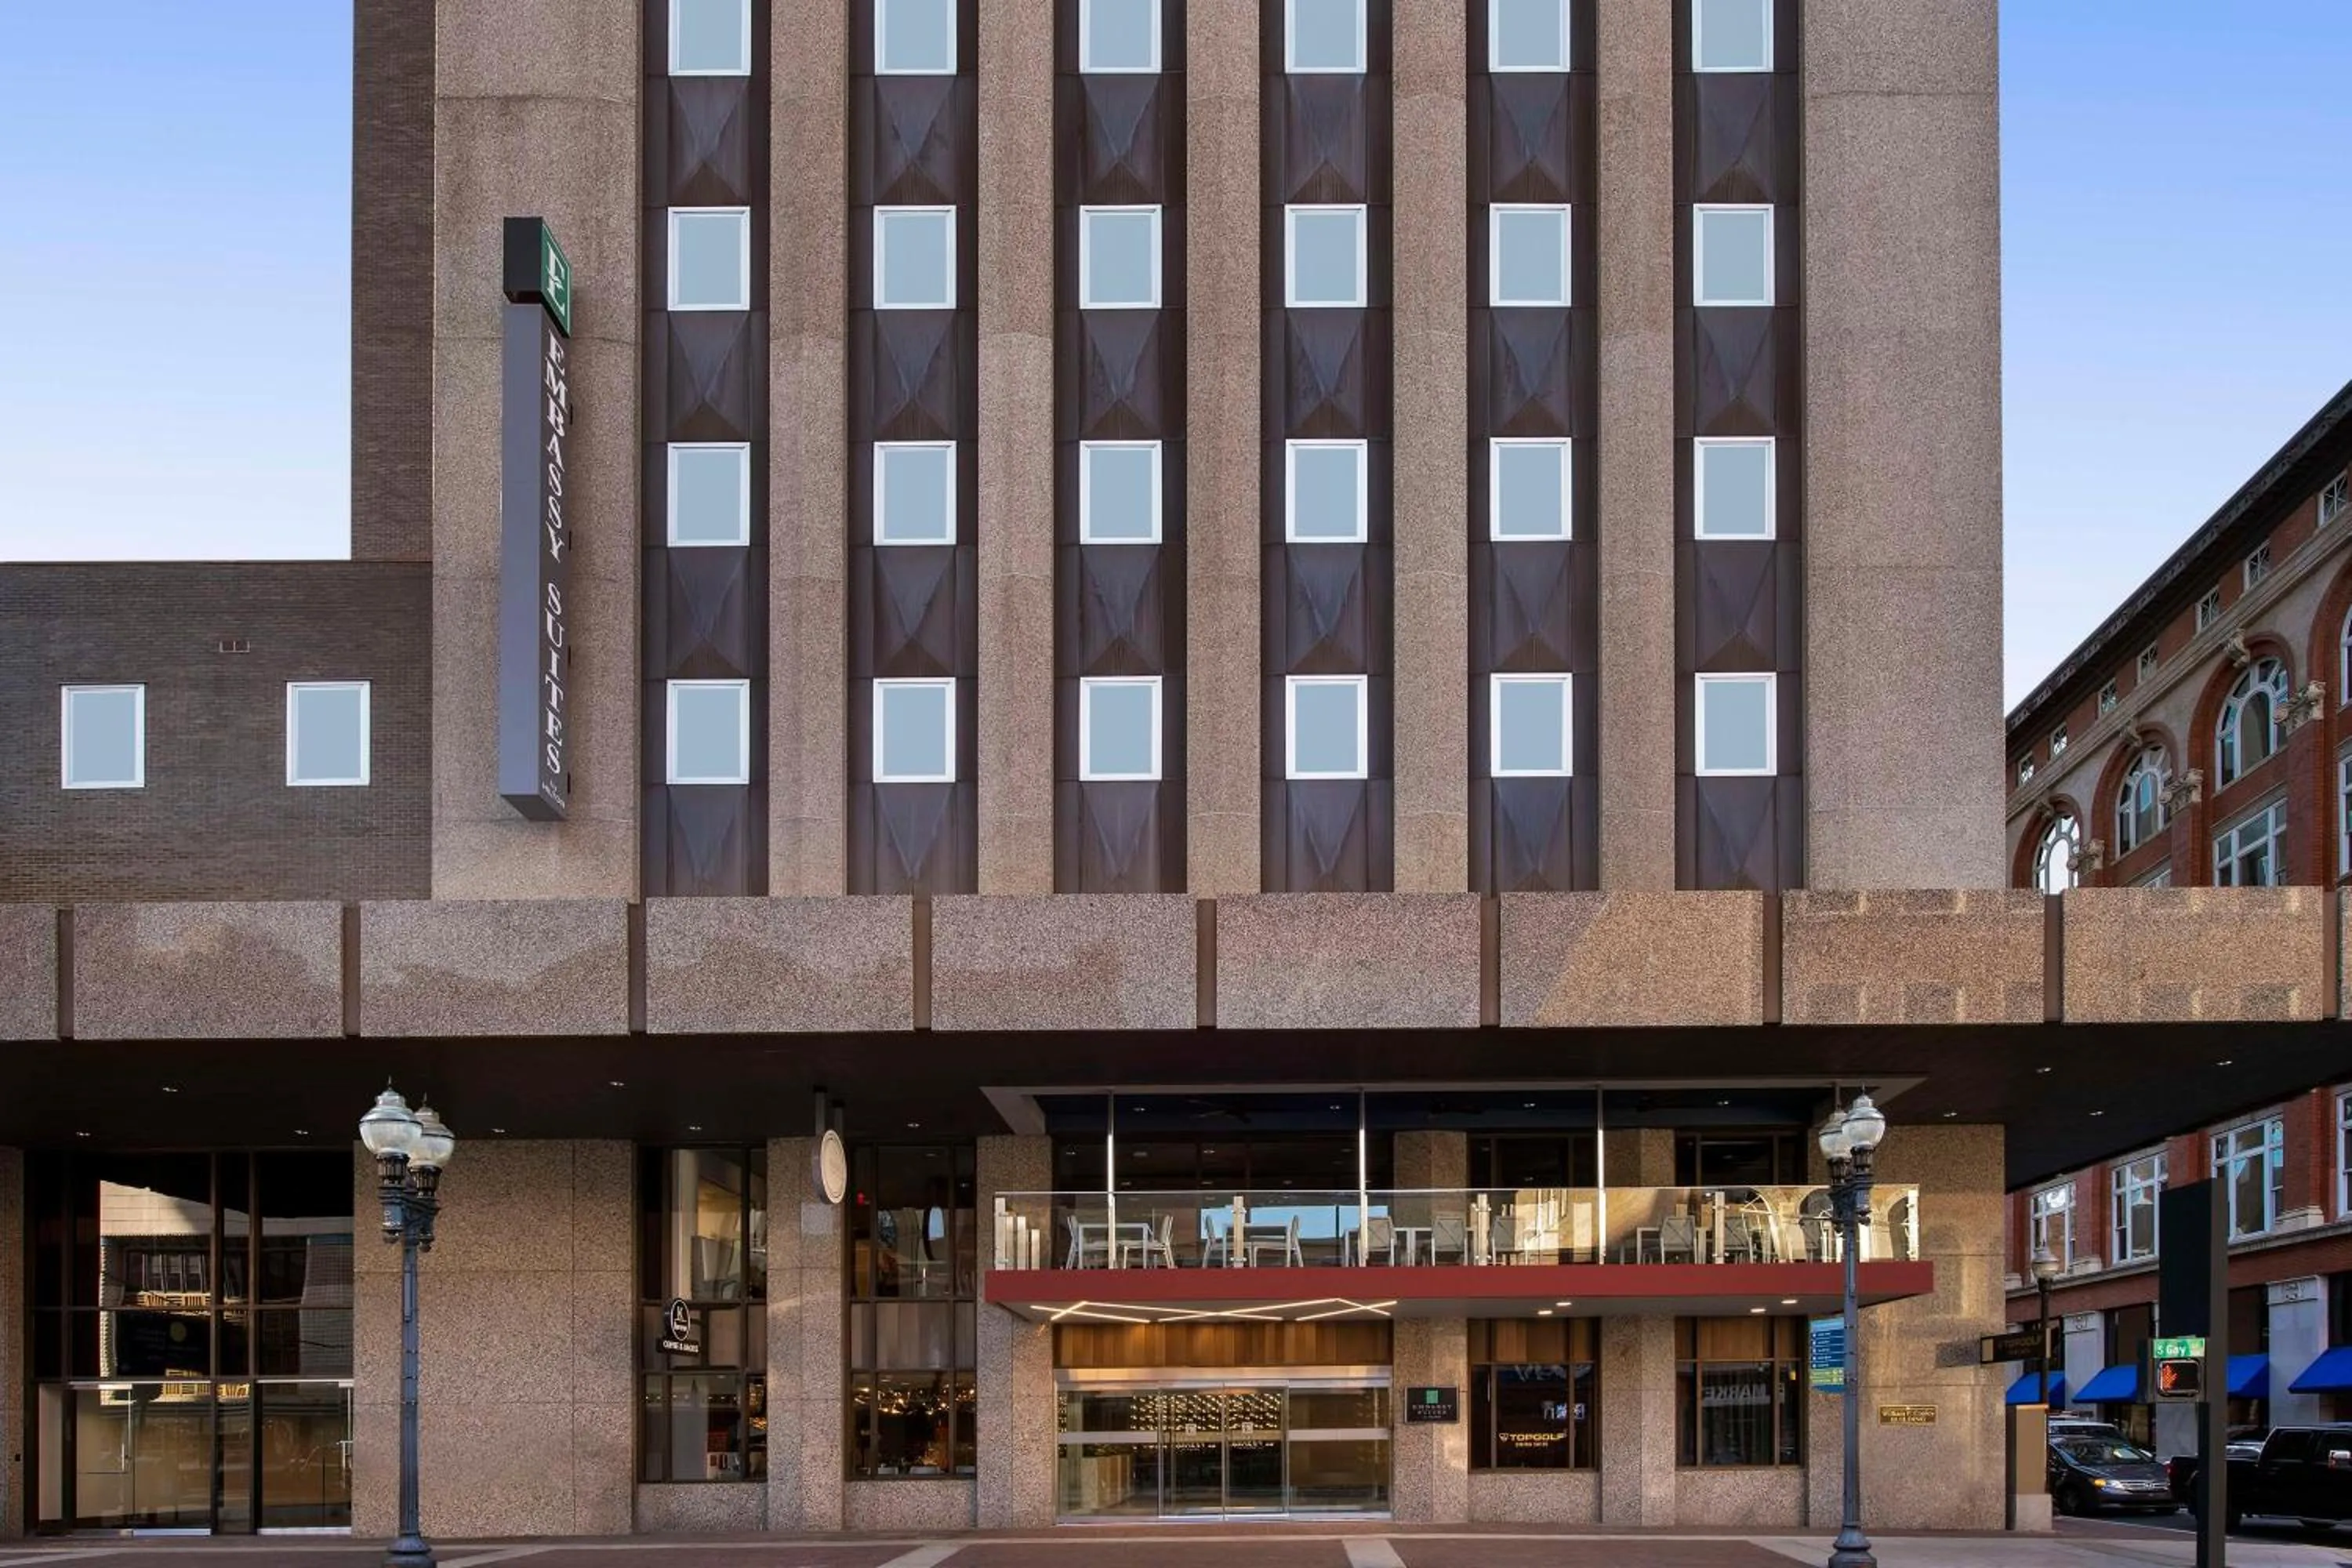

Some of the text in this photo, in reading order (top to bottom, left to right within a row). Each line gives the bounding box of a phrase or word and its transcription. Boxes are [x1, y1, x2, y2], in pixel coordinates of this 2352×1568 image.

[545, 328, 568, 563] EMBASSY
[545, 582, 565, 775] SUITES
[2166, 1345, 2186, 1357] Gay
